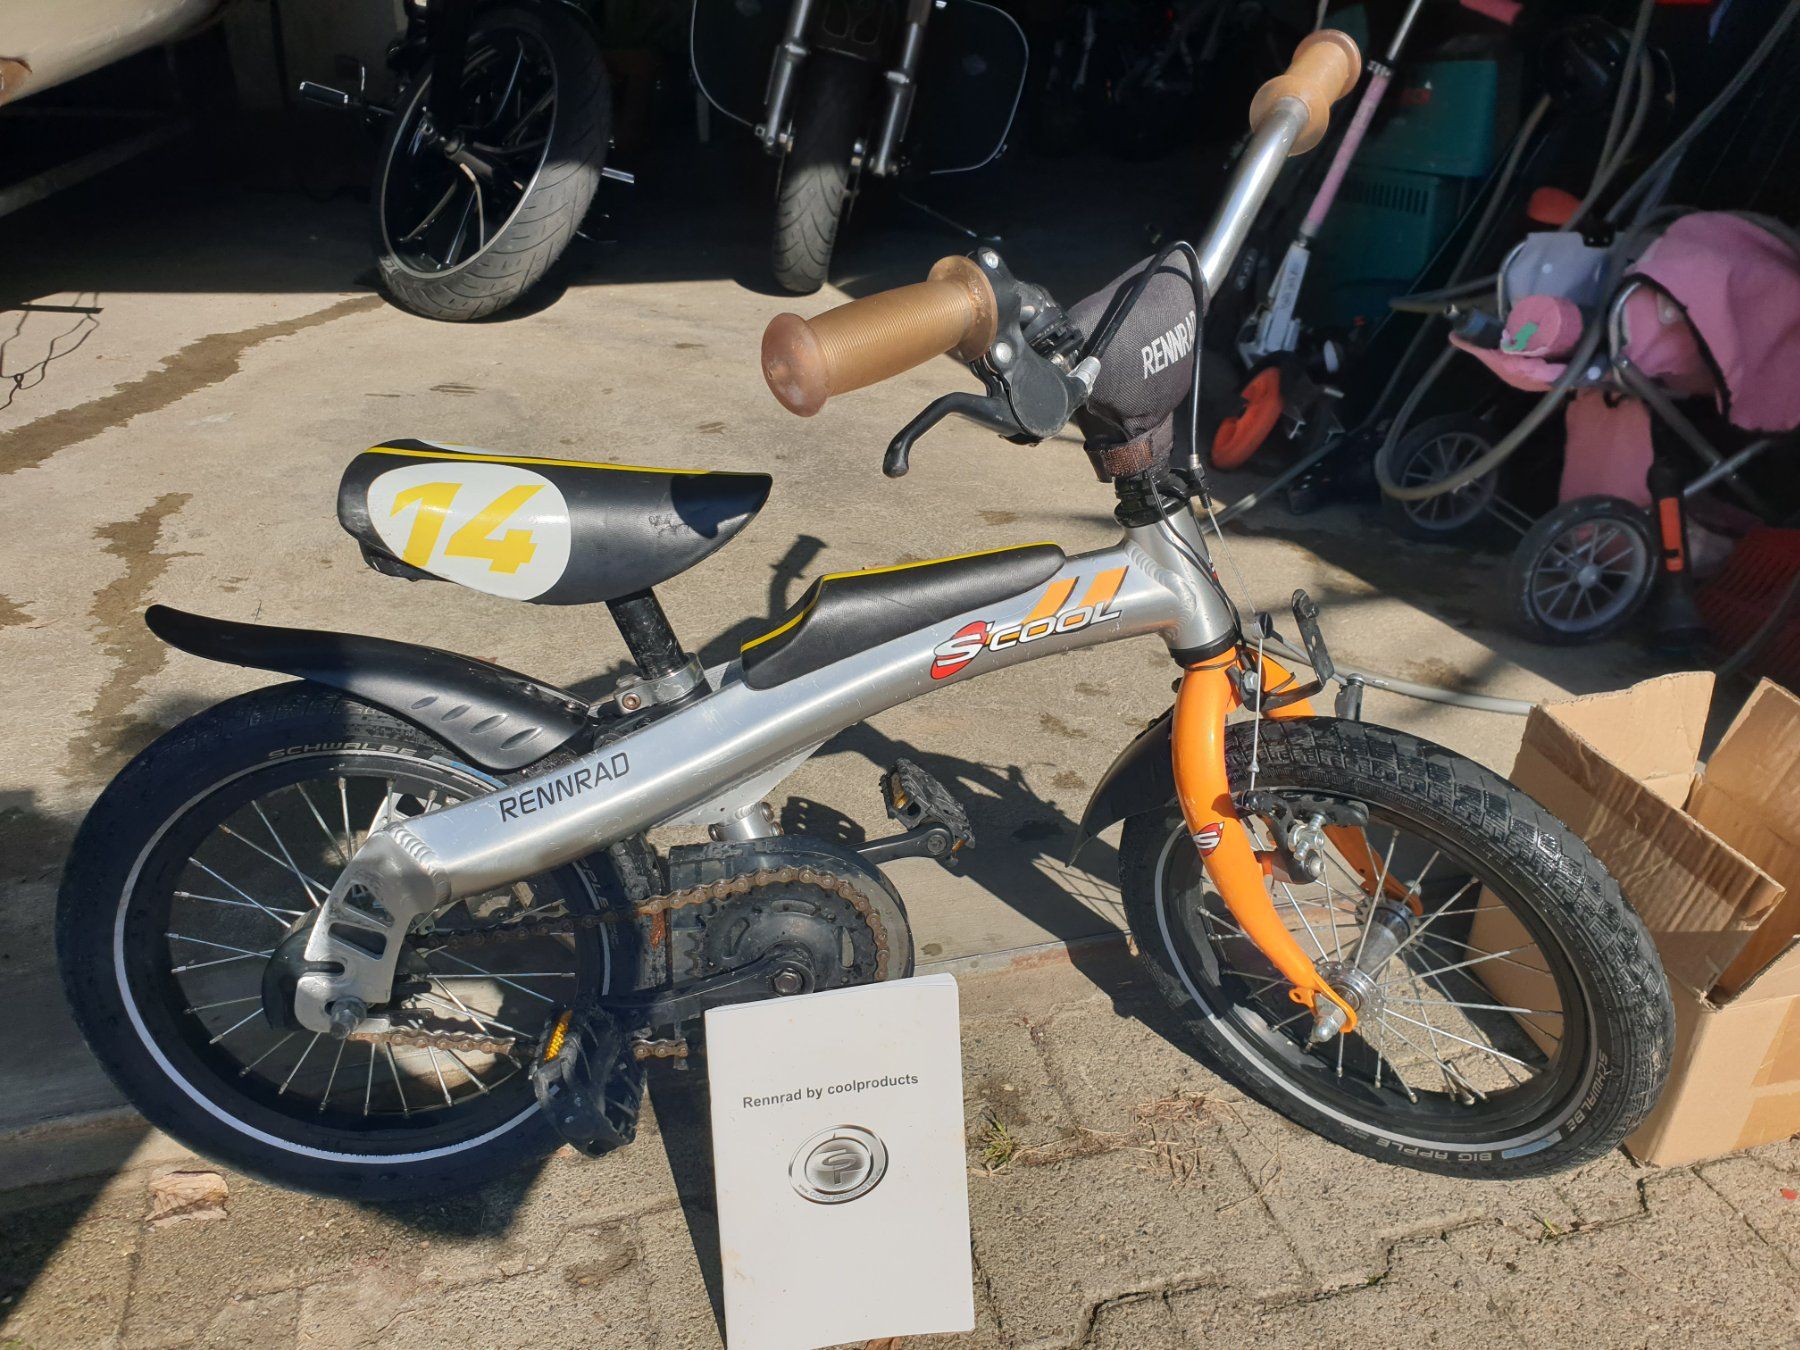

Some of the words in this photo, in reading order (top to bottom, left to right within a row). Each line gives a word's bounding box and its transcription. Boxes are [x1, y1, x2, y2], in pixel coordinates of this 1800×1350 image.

[389, 481, 546, 574] 14
[267, 742, 419, 760] SCHWALBE
[498, 752, 630, 822] RENNRAD
[742, 1089, 802, 1109] Rennrad
[806, 1087, 823, 1100] by
[827, 1074, 919, 1095] coolproducts
[1565, 1050, 1609, 1133] SCHWALBE
[1375, 1137, 1448, 1160] APPLE
[1457, 1152, 1493, 1162] BIG
